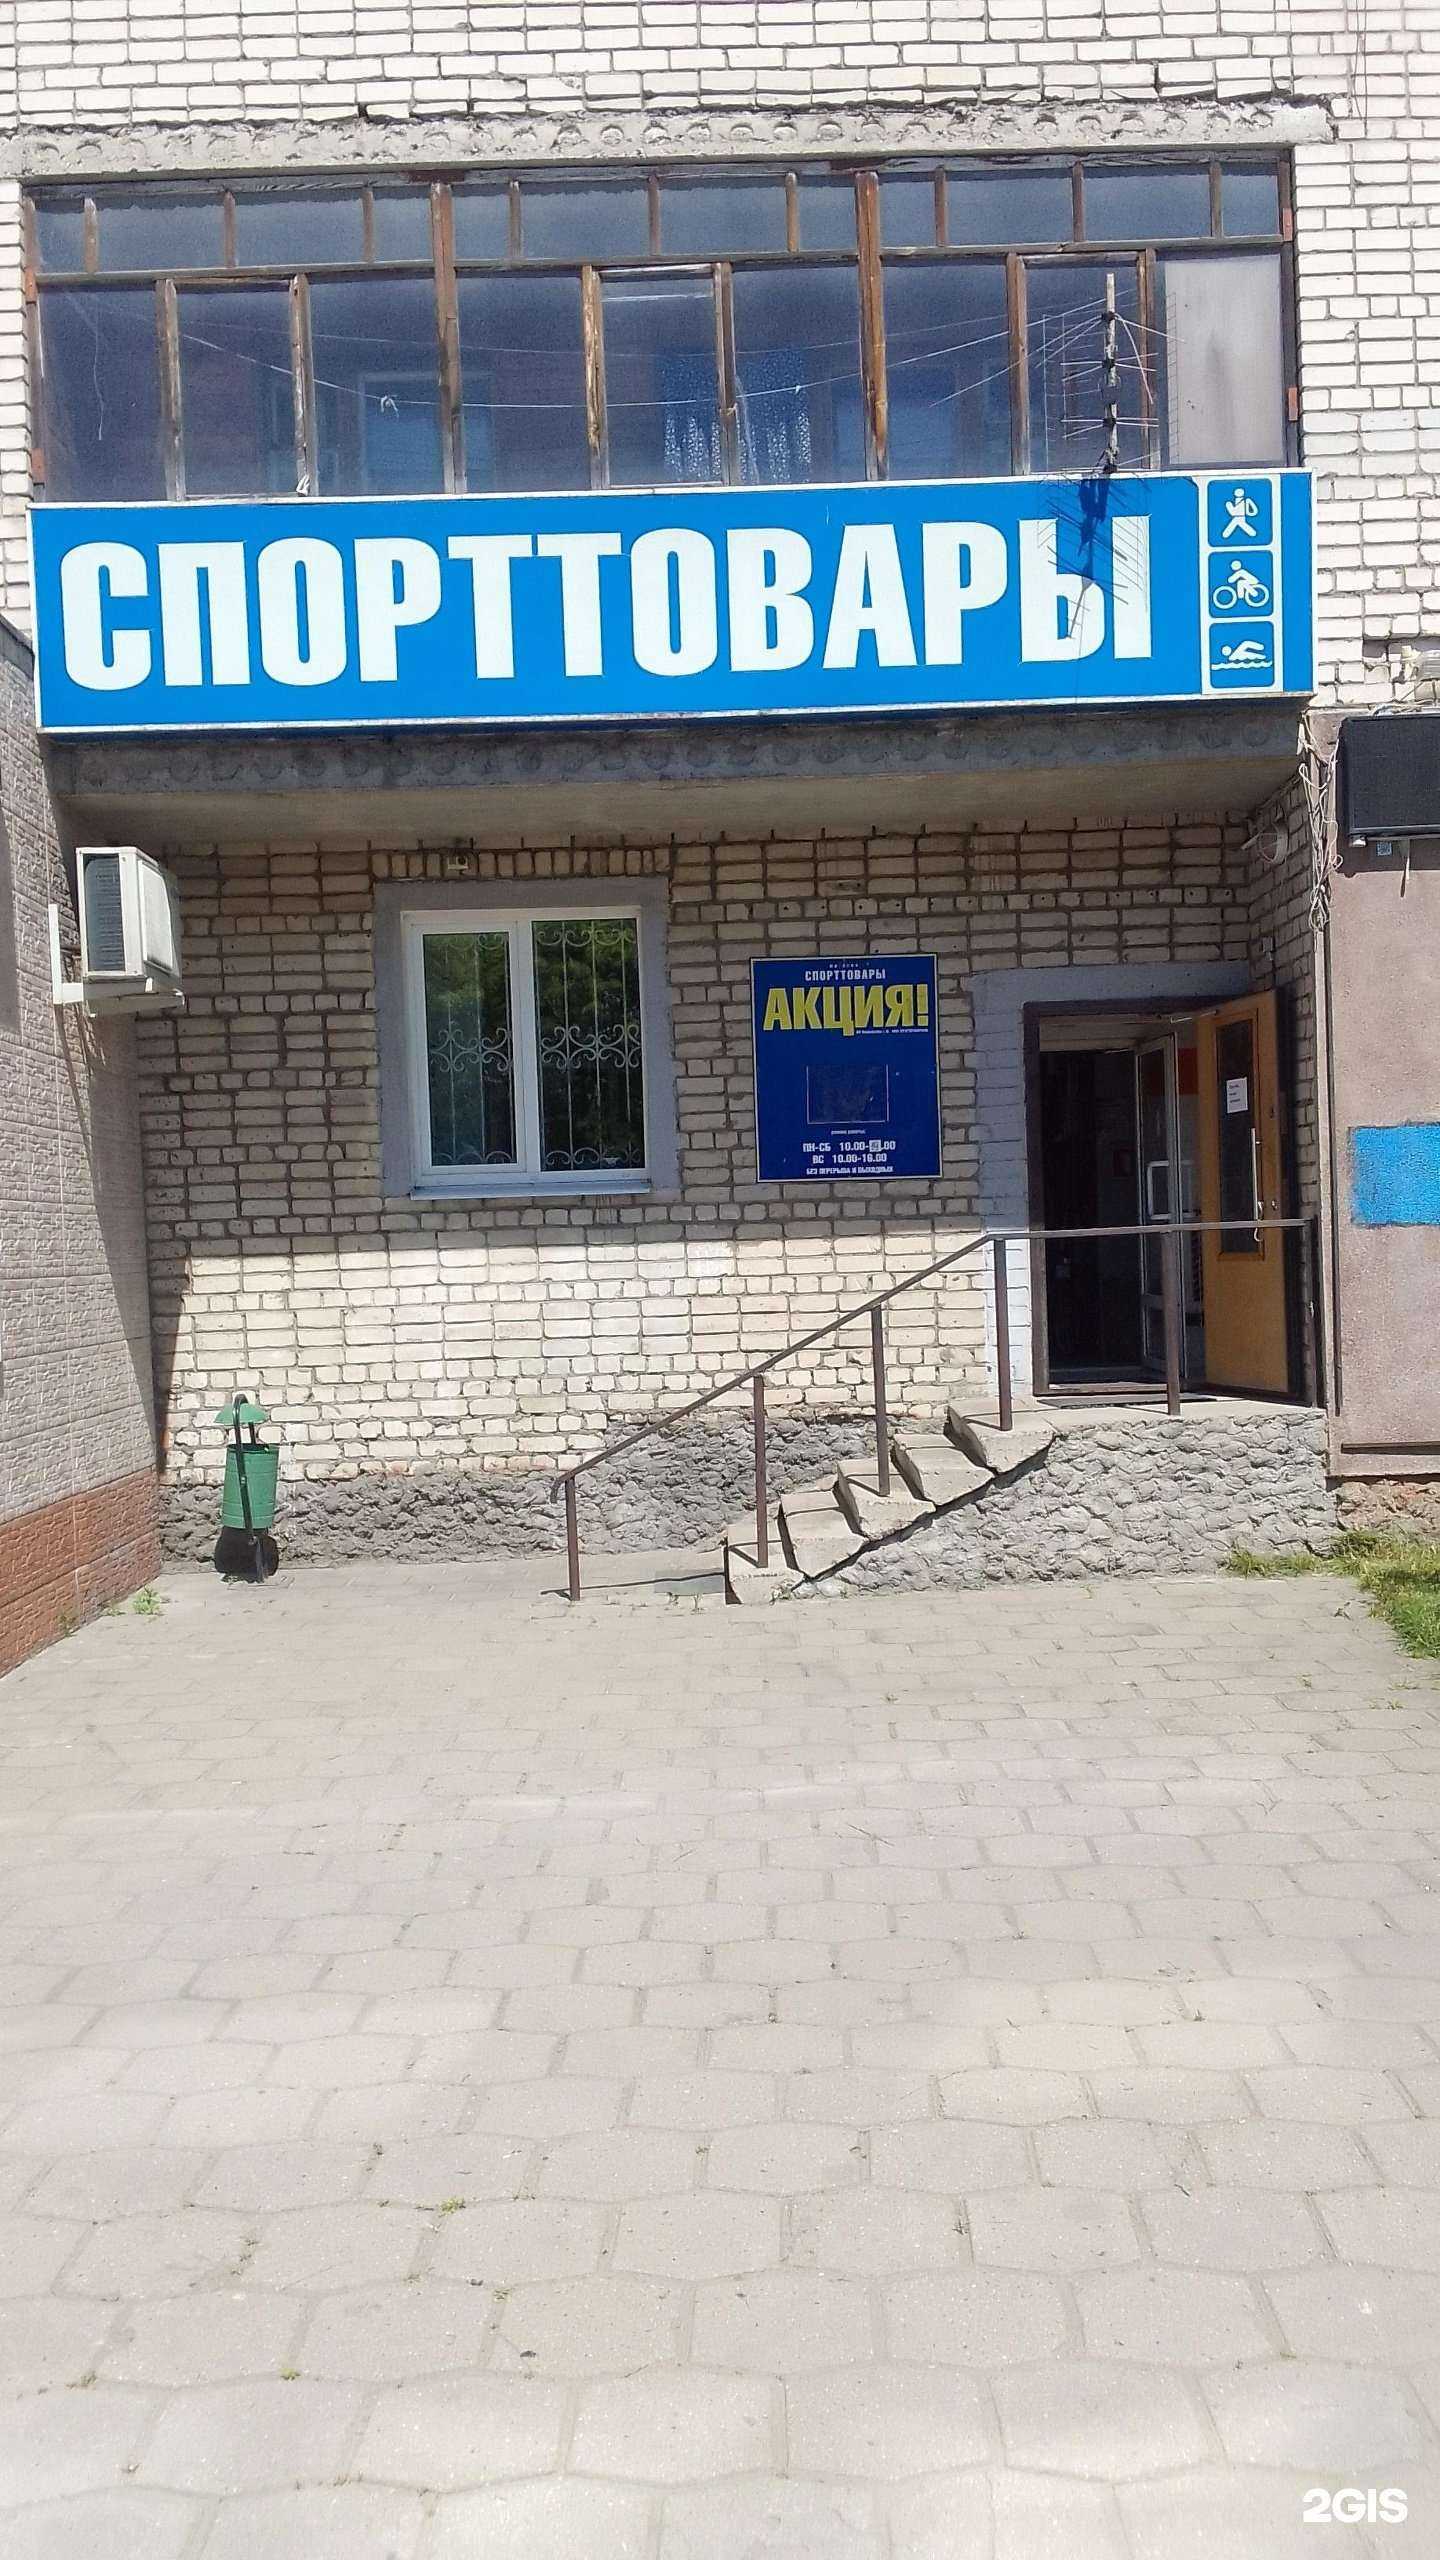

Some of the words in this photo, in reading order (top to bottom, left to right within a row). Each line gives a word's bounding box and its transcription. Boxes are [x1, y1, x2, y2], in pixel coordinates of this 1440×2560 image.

[61, 514, 1152, 691] СПОРТТОВАРЫ
[805, 969, 886, 981] СПОРТТОВАРЫ
[763, 984, 929, 1036] АКЦИЯ!
[802, 1142, 832, 1153] ПН-СБ
[839, 1140, 896, 1153] 10.00-.00
[812, 1154, 825, 1165] ВС
